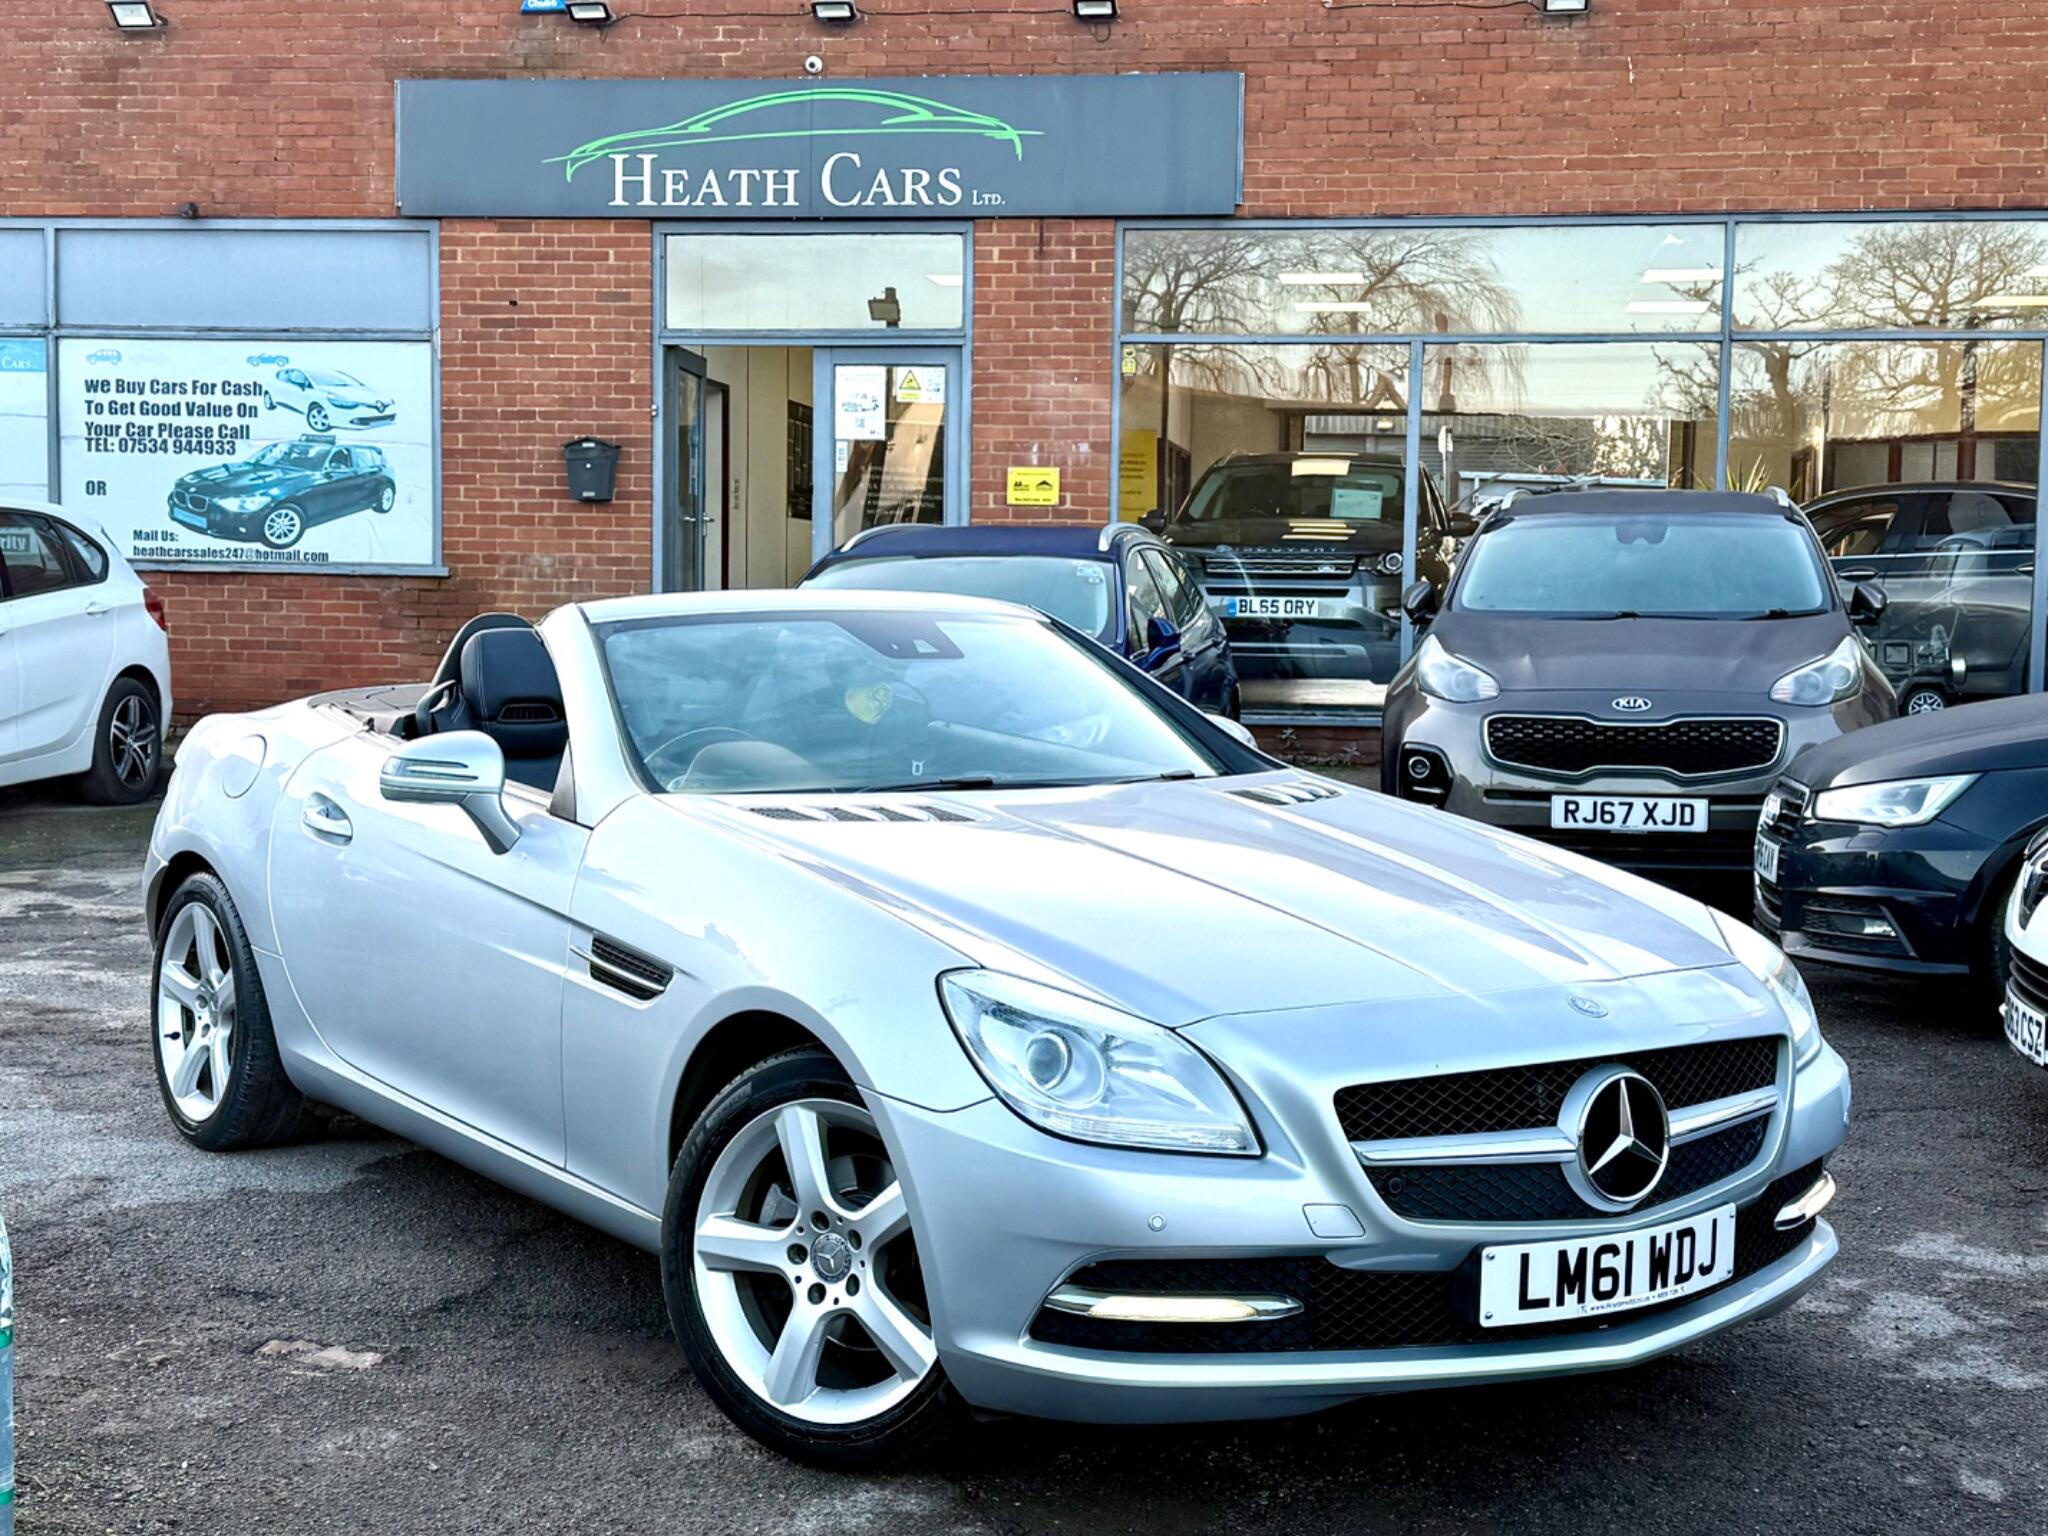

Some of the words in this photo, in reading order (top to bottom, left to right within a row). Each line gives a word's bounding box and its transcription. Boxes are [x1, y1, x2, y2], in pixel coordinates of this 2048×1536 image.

[115, 379, 146, 395] Buy
[150, 379, 188, 395] Cars
[191, 380, 217, 395] For
[221, 380, 263, 396] Cash
[85, 400, 104, 415] To
[108, 400, 136, 416] Get
[139, 400, 181, 416] Good
[185, 401, 233, 417] Value
[237, 402, 258, 418] On
[85, 421, 122, 437] Your
[125, 422, 154, 438] Car
[158, 422, 214, 439] Please
[217, 424, 250, 440] Call
[85, 438, 114, 452] TEL:
[118, 438, 169, 454] 07534
[173, 439, 236, 455] 944933
[85, 480, 107, 496] OR
[133, 529, 158, 541] Mail
[161, 530, 179, 542] Us:
[133, 545, 329, 562] heathcarssales247@hotmail.com
[1618, 698, 1647, 708] KIA
[1564, 800, 1634, 825] RJ67
[1643, 802, 1695, 826] XJD
[1518, 1240, 1634, 1311] LM61
[1649, 1218, 1718, 1292] WDJ
